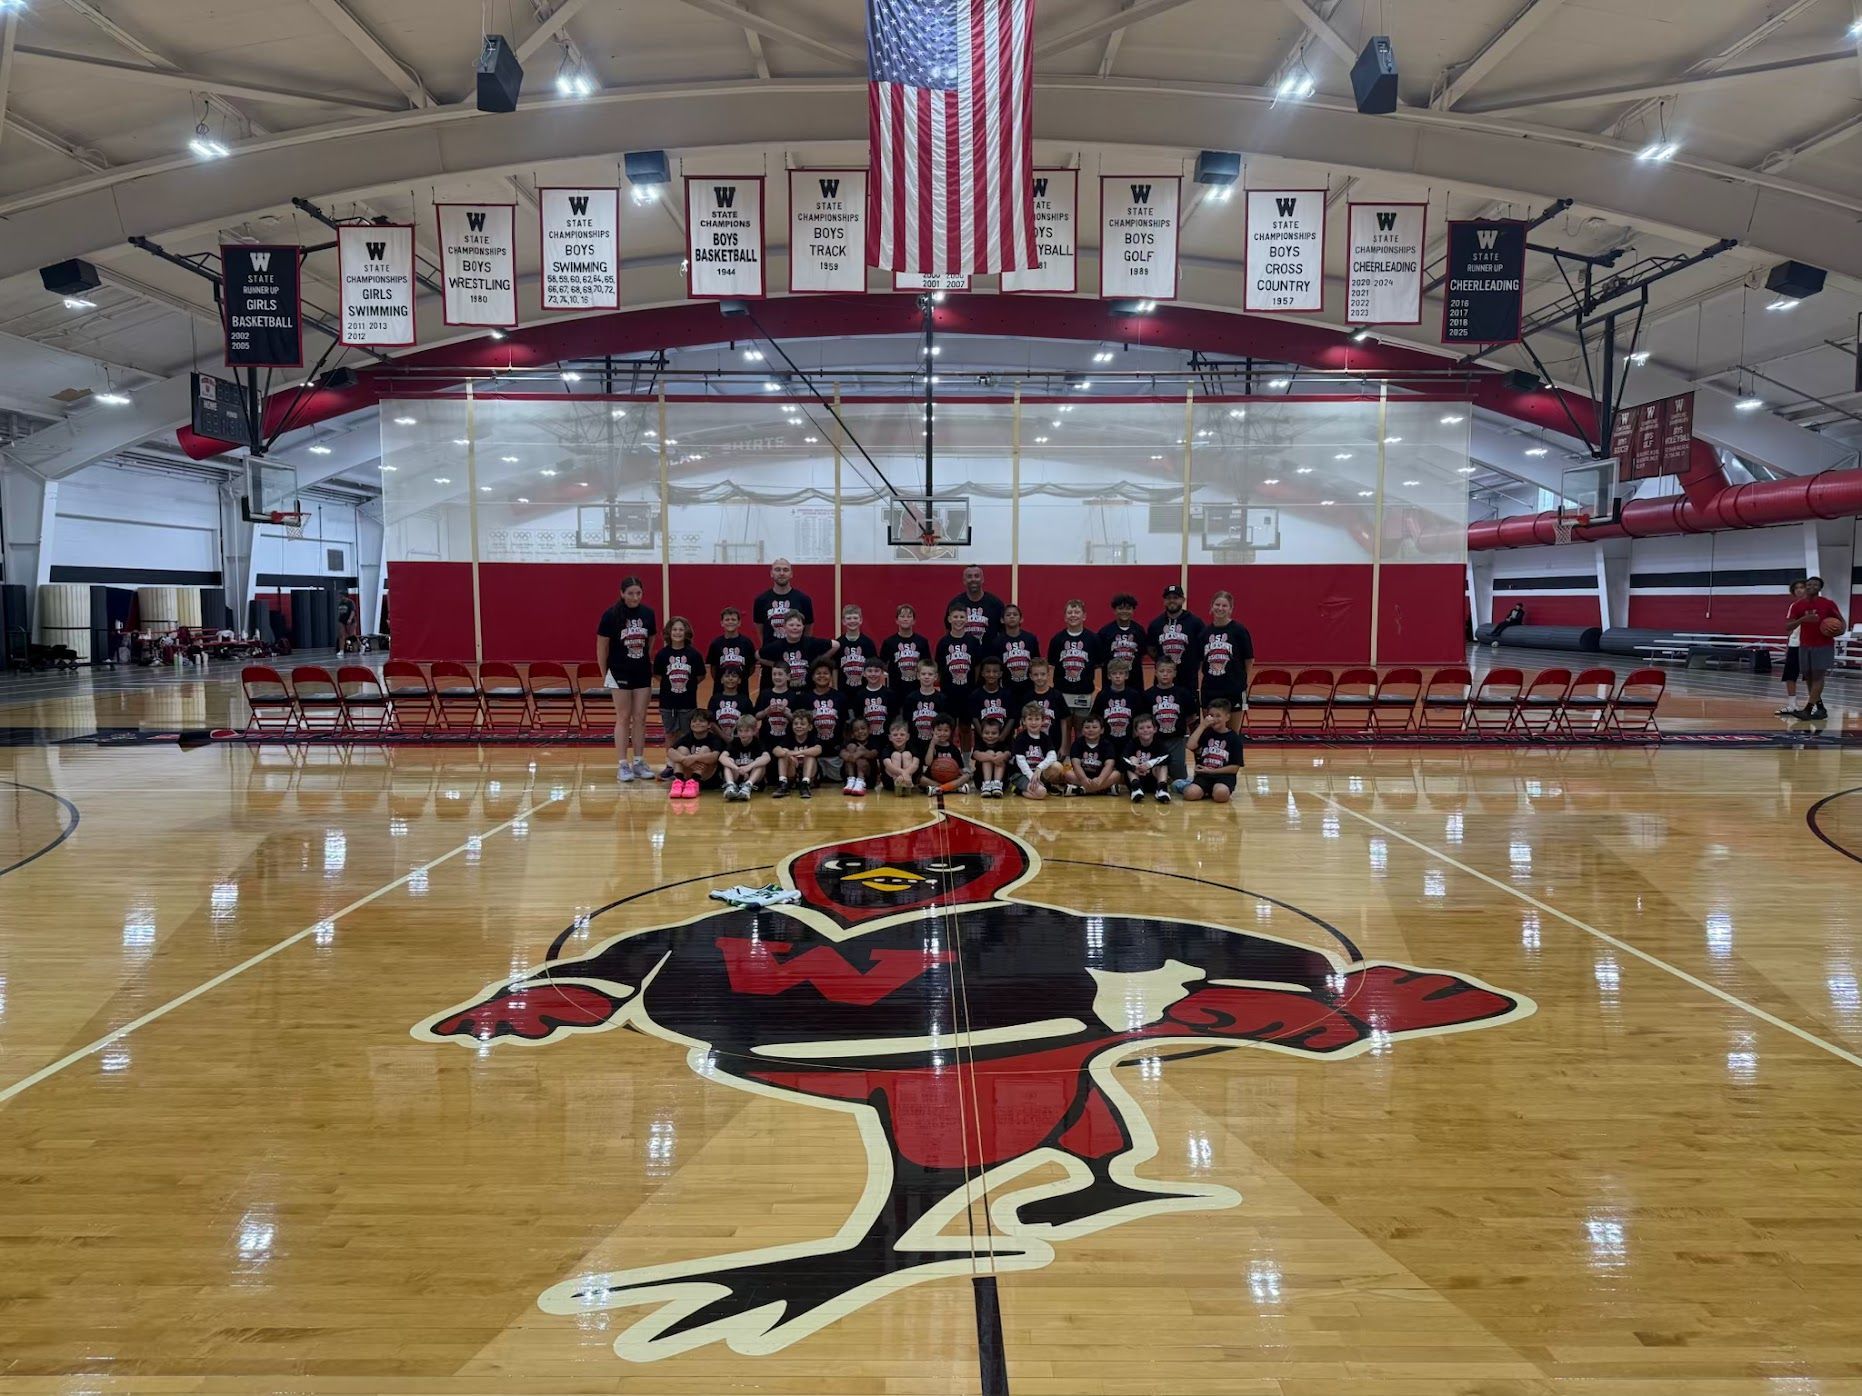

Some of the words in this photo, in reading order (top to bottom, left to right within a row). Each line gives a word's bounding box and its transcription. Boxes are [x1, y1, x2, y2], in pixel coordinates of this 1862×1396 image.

[819, 179, 839, 198] W
[1033, 179, 1048, 197] W
[714, 187, 735, 208] W
[1131, 185, 1151, 203] W
[569, 196, 589, 216] W
[816, 202, 842, 210] STATE
[1276, 198, 1296, 217] W
[466, 213, 485, 232] W
[567, 219, 592, 227] STATE
[798, 213, 858, 222] CHAMPIONSHIPS
[1377, 213, 1396, 231] W
[549, 231, 609, 239] CHAMPIONSHIPS
[814, 228, 843, 239] BOYS
[1125, 233, 1154, 244] BOYS
[1254, 232, 1316, 240] CHAMPIONSHIPS
[464, 236, 489, 244] STATE
[713, 233, 738, 246] BOYS
[1477, 230, 1498, 249] W
[366, 242, 385, 260] W
[448, 247, 506, 256] CHAMPIONSHIPS
[565, 245, 594, 256] BOYS
[696, 249, 757, 262] BASKETBALL
[810, 245, 846, 256] TRACK
[1270, 246, 1299, 257] BOYS
[1355, 246, 1416, 254] CHAMPIONSHIPS
[1124, 251, 1154, 262] GOLF
[250, 253, 270, 272] W
[463, 261, 491, 272] BOYS
[553, 262, 607, 272] SWIMMING
[820, 262, 838, 270] 1959
[1353, 262, 1416, 272] CHEERLEADING
[1467, 264, 1493, 272] RUNNER
[1494, 264, 1503, 272] UP
[1266, 264, 1303, 274] CROSS
[248, 275, 273, 283] STATE
[347, 276, 407, 284] CHAMPIONSHIPS
[449, 277, 510, 290] WRESTLING
[1374, 279, 1393, 287] 2024
[243, 286, 269, 294] RUNNER
[270, 286, 279, 294] UP
[1258, 280, 1310, 292] COUNTRY
[1450, 280, 1519, 291] CHEERLEADING
[363, 289, 392, 299] GIRLS
[471, 295, 487, 303] 1980
[247, 299, 277, 310] GIRLS
[349, 306, 407, 316] SWIMMING
[232, 316, 292, 328] BASKETBALL
[1675, 399, 1684, 412] W
[1647, 406, 1655, 418] W
[1622, 413, 1629, 424] W
[714, 937, 956, 1006] W
